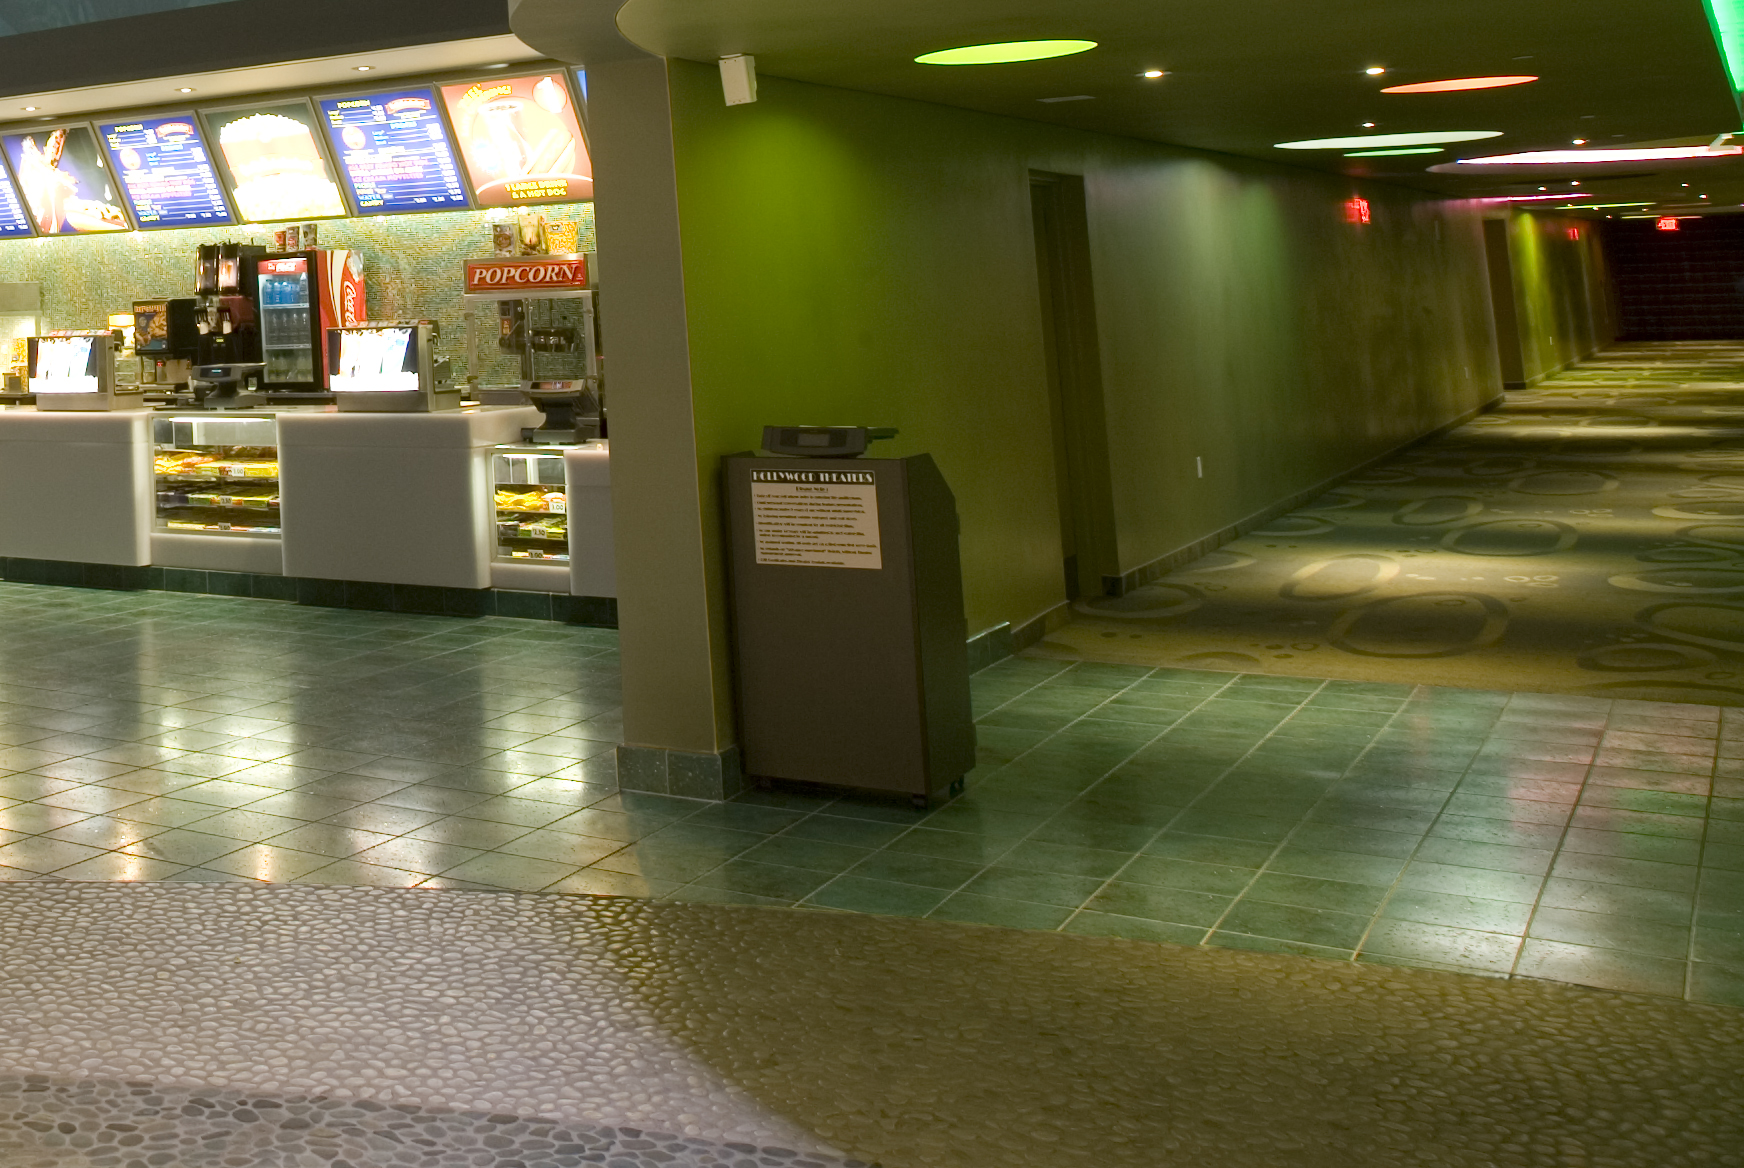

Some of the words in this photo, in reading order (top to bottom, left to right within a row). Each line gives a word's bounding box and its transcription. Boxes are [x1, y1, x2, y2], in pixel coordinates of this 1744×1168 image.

[526, 189, 545, 197] HOT
[547, 188, 566, 196] DOG
[472, 264, 576, 284] POPCORN
[752, 471, 816, 482] HOLLYWOOD
[818, 472, 873, 483] THEATERS
